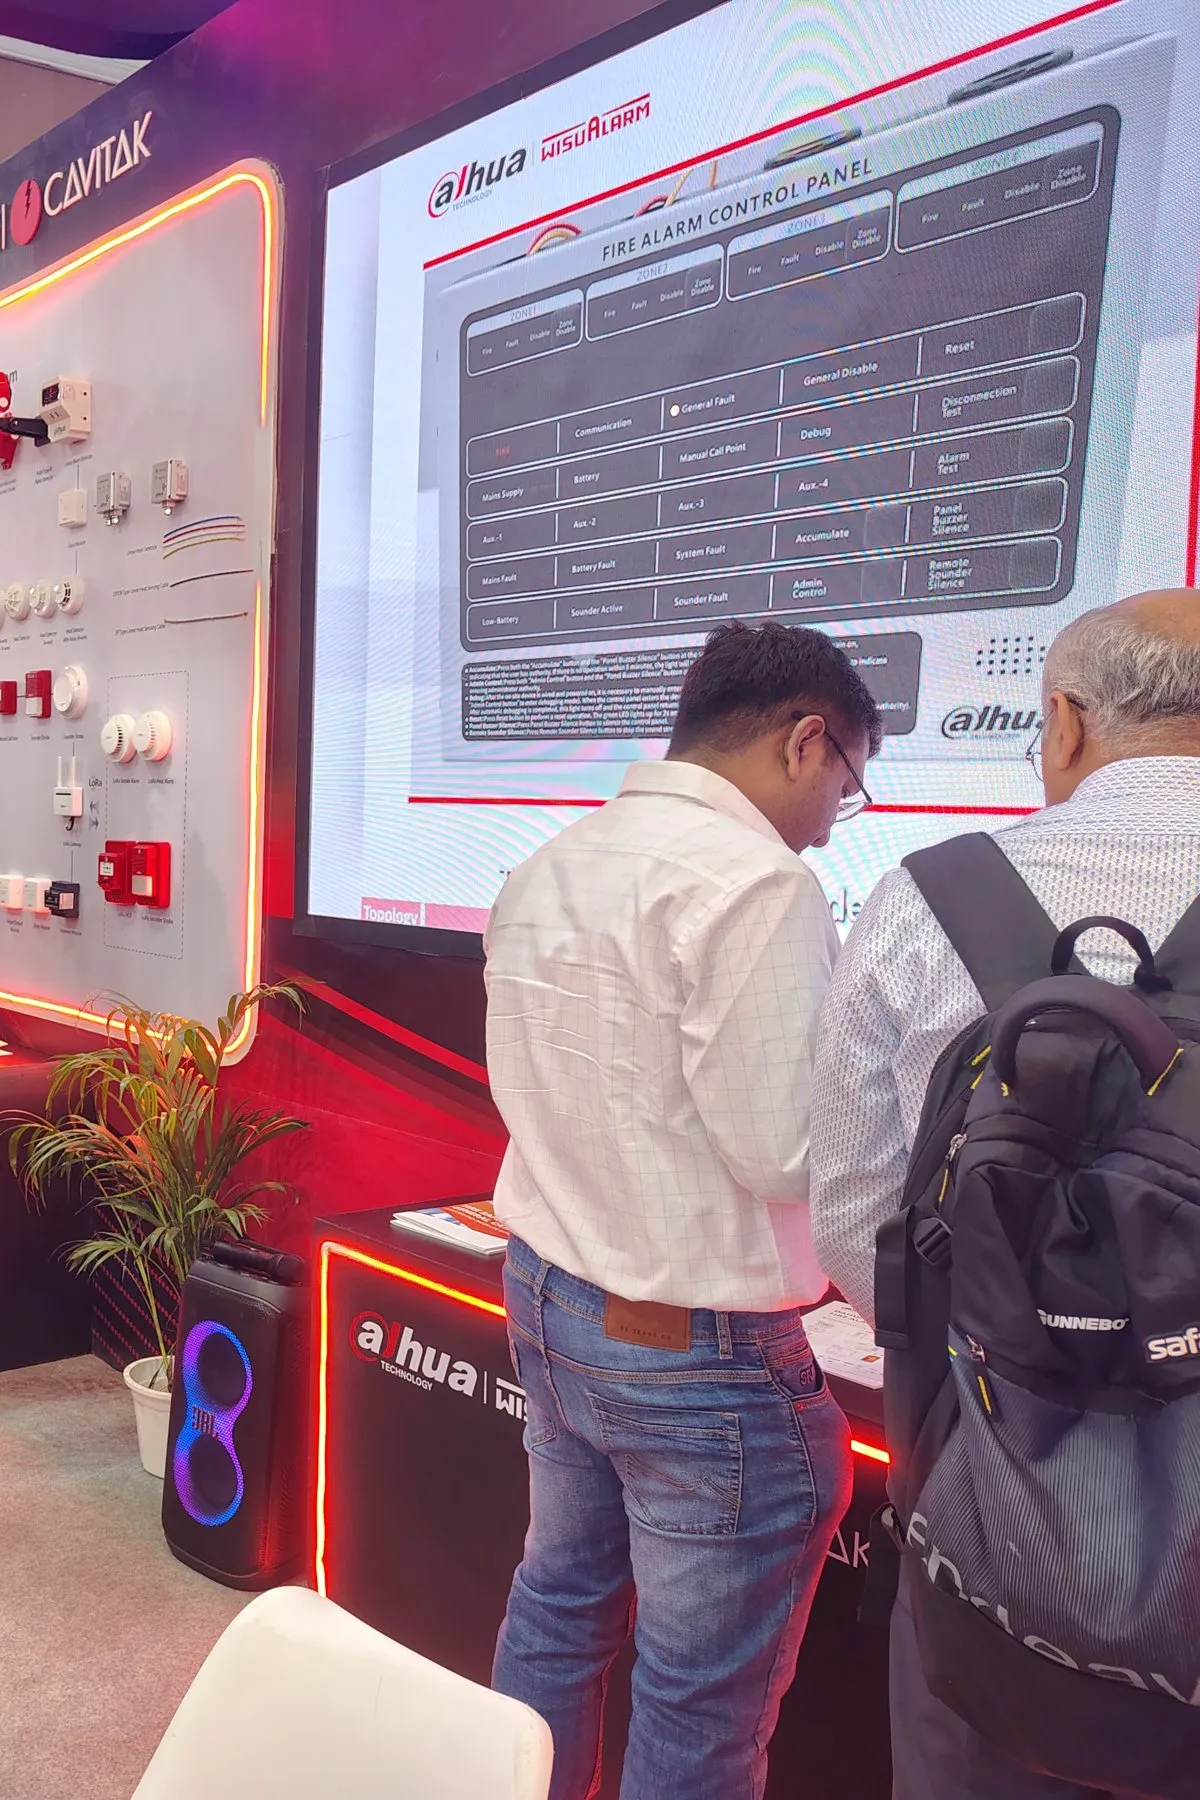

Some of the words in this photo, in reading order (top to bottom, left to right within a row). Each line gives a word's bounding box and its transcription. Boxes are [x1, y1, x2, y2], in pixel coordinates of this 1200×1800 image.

[44, 111, 152, 216] CAVITAK
[453, 189, 494, 211] TECHNOLOGY
[602, 237, 636, 261] FIRE
[641, 214, 703, 248] ALARM
[709, 186, 800, 225] CONTROL
[807, 158, 872, 193] PANEL
[815, 240, 845, 257] Disable
[631, 298, 648, 310] Fault
[660, 288, 684, 302] Disable
[530, 329, 550, 342] Disable
[944, 340, 975, 355] Reset
[803, 371, 840, 387] General
[841, 362, 879, 380] Disable
[942, 384, 1017, 408] Disconnection
[682, 398, 712, 414] General
[714, 394, 735, 409] Fault
[942, 406, 963, 418] Test
[574, 417, 632, 438] Communication
[800, 426, 831, 441] Debug
[679, 450, 708, 464] Manual
[709, 446, 723, 458] Call
[724, 442, 747, 456] Point
[937, 451, 971, 465] Alarm
[937, 463, 959, 475] Test
[573, 472, 600, 485] Battery
[482, 490, 501, 502] Mains
[501, 486, 524, 500] Supply
[933, 502, 963, 516] Panel
[933, 512, 969, 526] Buzzer
[795, 528, 850, 544] Accumulate
[932, 522, 970, 537] Silence
[675, 548, 705, 561] System
[705, 544, 726, 556] Fault
[571, 563, 597, 575] Battery
[598, 559, 616, 570] Fault
[929, 556, 970, 570] Remote
[482, 575, 499, 586] Mains
[500, 573, 517, 583] Fault
[928, 567, 973, 581] Sounder
[792, 578, 823, 590] Admin
[927, 577, 965, 591] Silence
[674, 595, 707, 607] Sounder
[708, 592, 728, 603] Fault
[792, 586, 827, 599] Control
[571, 607, 598, 618] Sounder
[600, 604, 623, 615] Active
[482, 615, 519, 627] Low-Battery
[364, 905, 419, 926] Topology
[1148, 1327, 1200, 1360] saf
[381, 1360, 433, 1391] TECHNOLOGY
[192, 1406, 219, 1438] JBL
